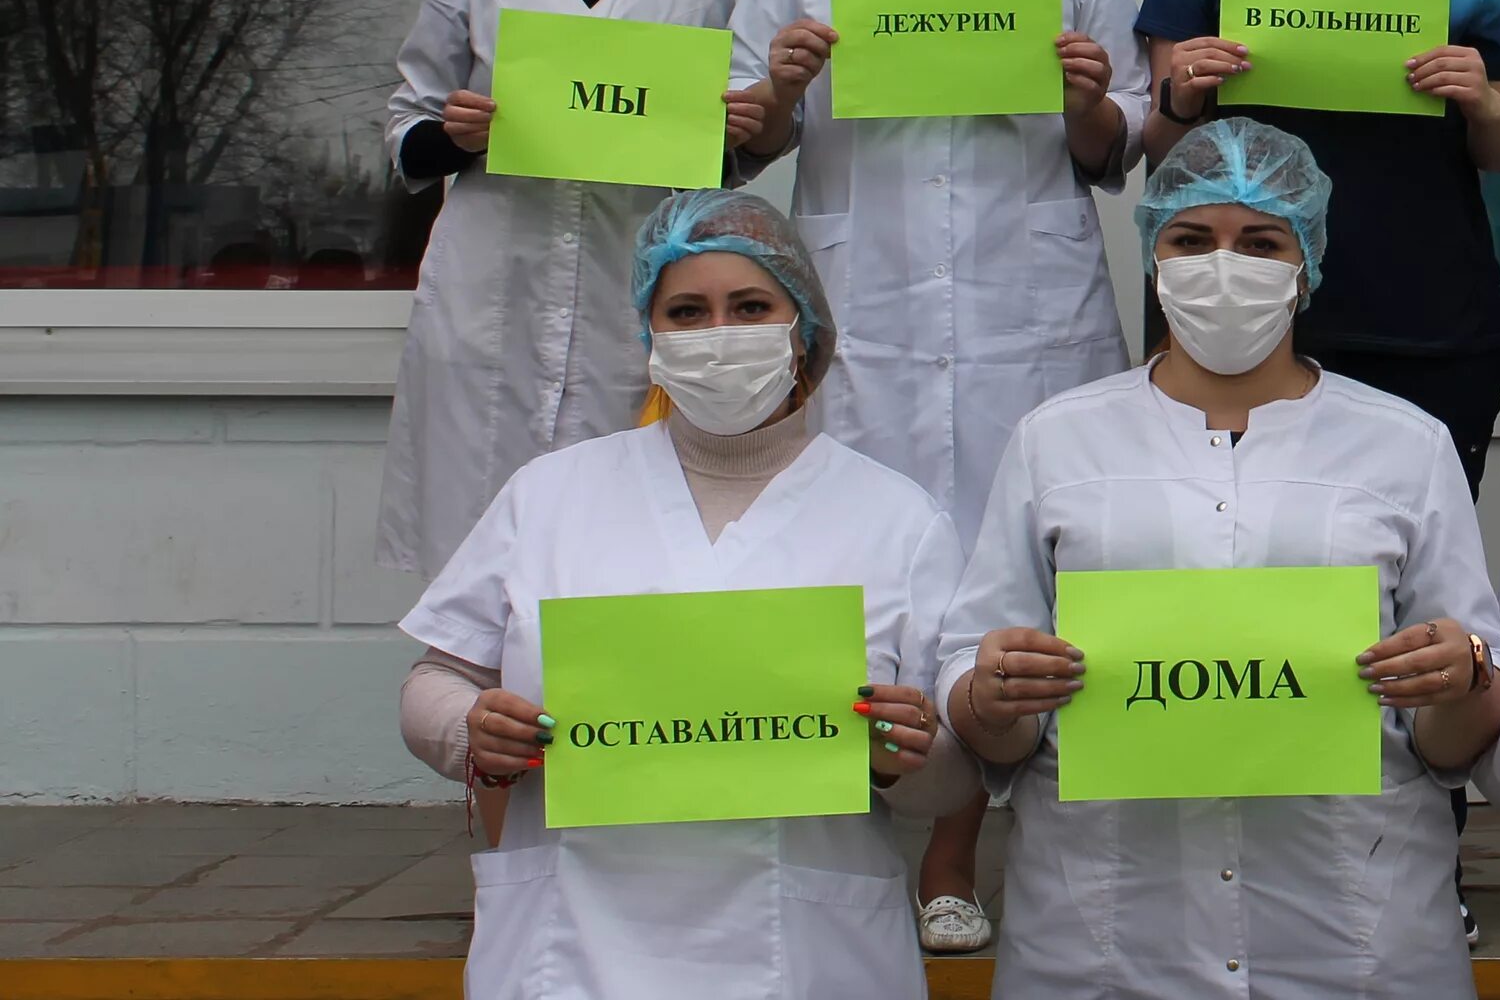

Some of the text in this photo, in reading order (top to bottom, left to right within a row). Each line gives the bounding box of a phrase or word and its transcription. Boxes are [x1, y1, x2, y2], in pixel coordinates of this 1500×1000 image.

[873, 12, 1016, 38] ДЕЖУРИМ
[1245, 7, 1421, 37] В БОЛЬНИЦЕ
[568, 80, 650, 117] МЫ
[1126, 659, 1308, 711] ДОМА
[569, 710, 840, 748] ОСТАВАЙТЕСЬ
